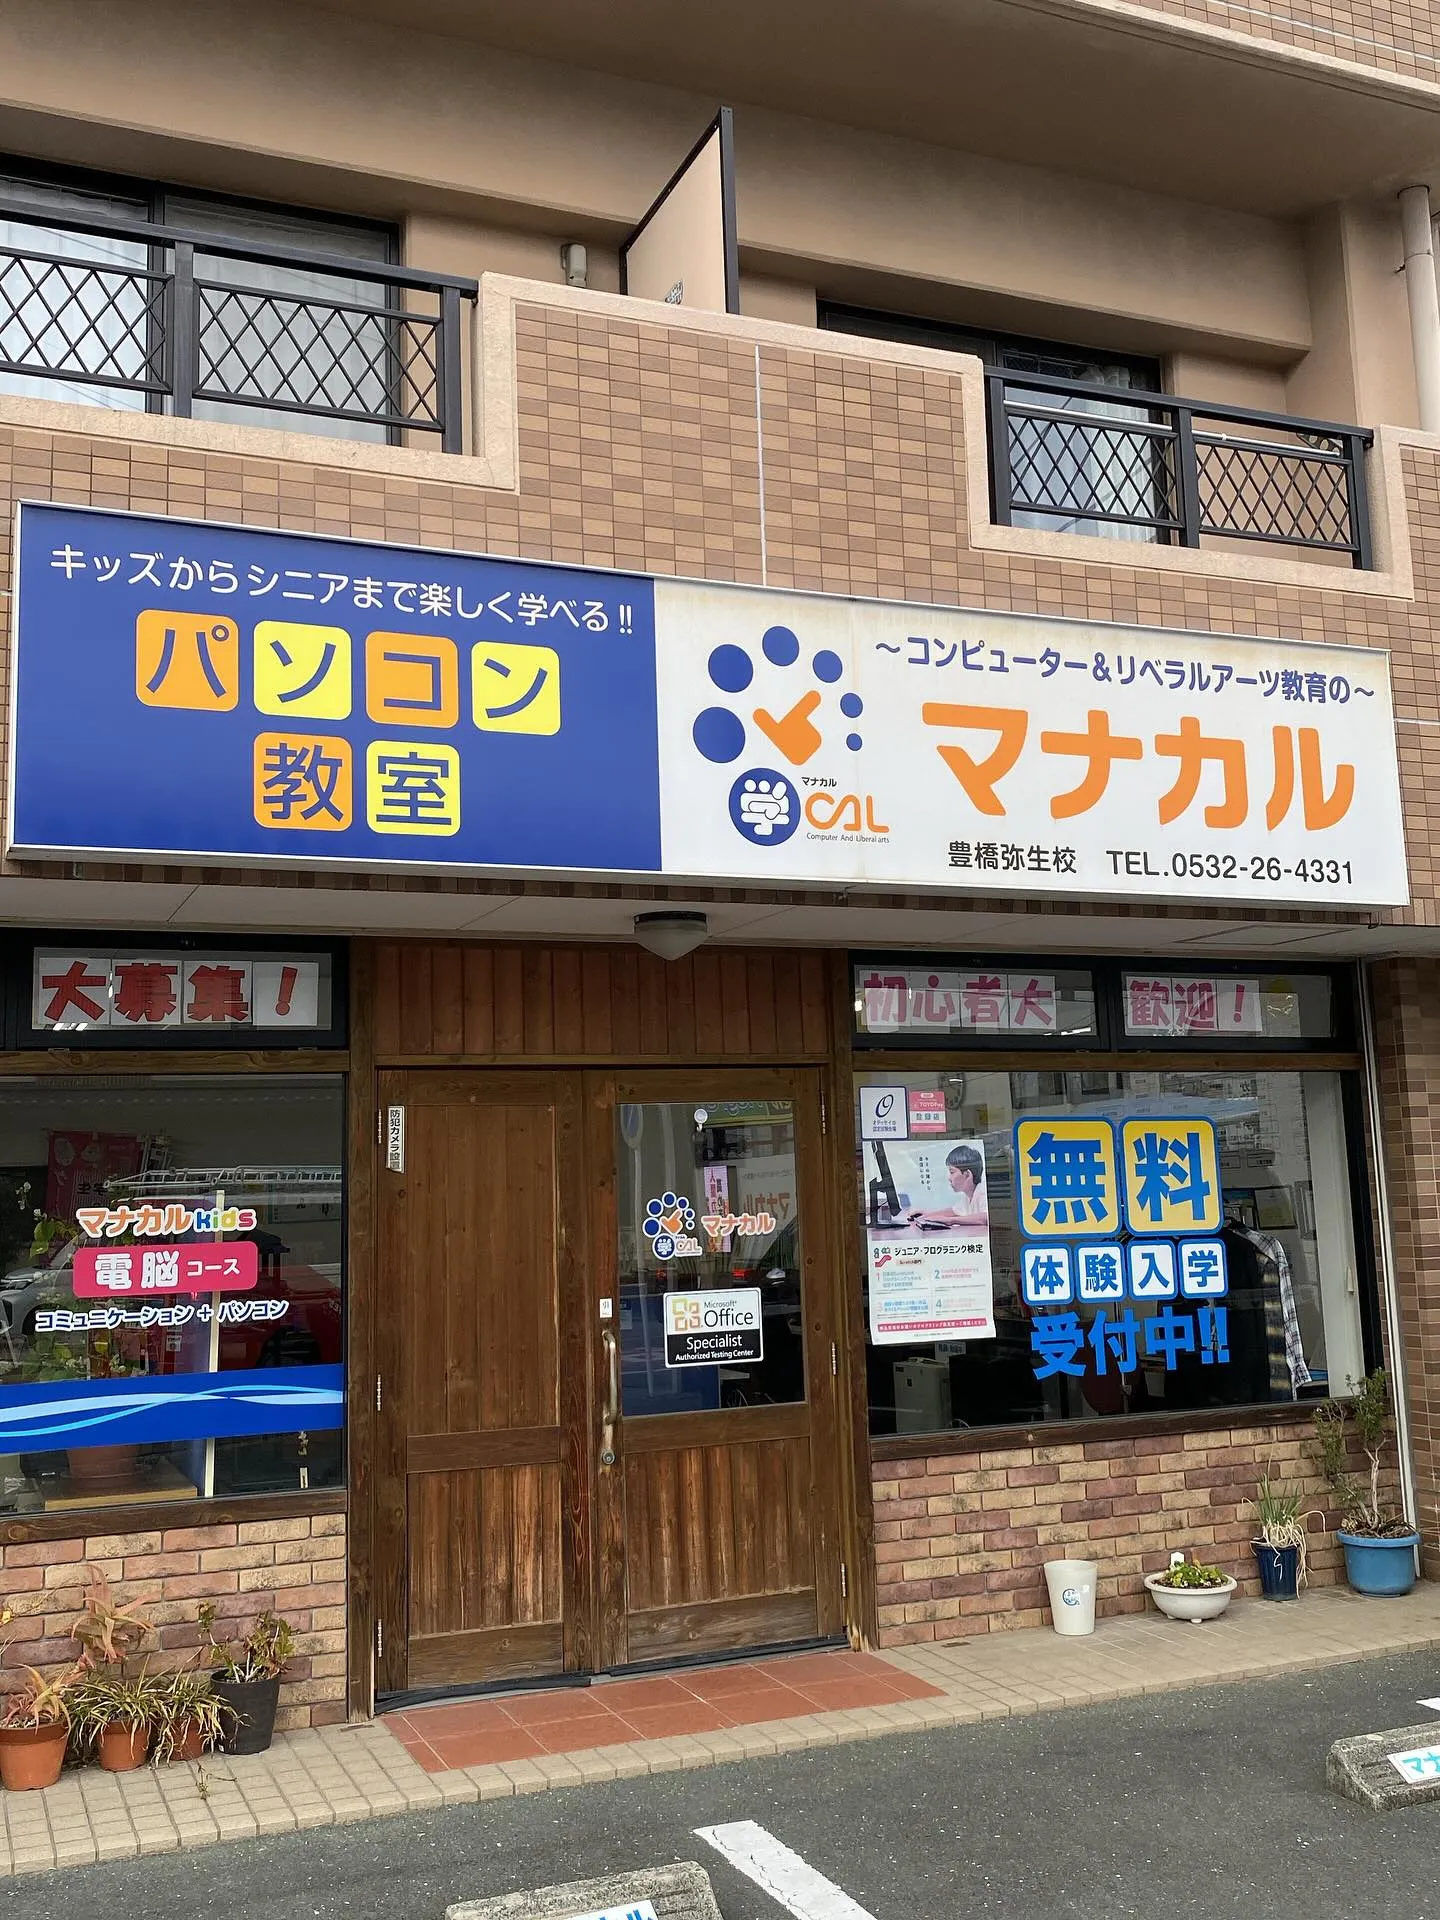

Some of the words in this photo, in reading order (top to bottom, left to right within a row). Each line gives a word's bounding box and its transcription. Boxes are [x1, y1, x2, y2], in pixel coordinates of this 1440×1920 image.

[144, 624, 549, 719] パソコン
[262, 742, 454, 828] 教室
[801, 776, 838, 788] マナカル
[921, 702, 1356, 832] マナカル
[806, 832, 838, 842] Computer
[840, 834, 854, 843] And
[855, 834, 877, 844] Liberal
[947, 841, 1078, 875] 豊橋弥生校
[1106, 850, 1354, 885] TEL.0532-26-4331
[42, 961, 299, 1022] 大募集!
[864, 972, 1053, 1026] 初心者大
[1129, 979, 1246, 1030] 歓迎!
[1027, 1131, 1211, 1227] 無料
[701, 1212, 776, 1237] マナカル
[1029, 1248, 1220, 1294] 体験入学
[703, 1308, 754, 1328] Office
[675, 1352, 711, 1361] Authorized
[711, 1350, 733, 1359] Testing
[733, 1349, 754, 1357] Center
[686, 1334, 743, 1353] Specialist
